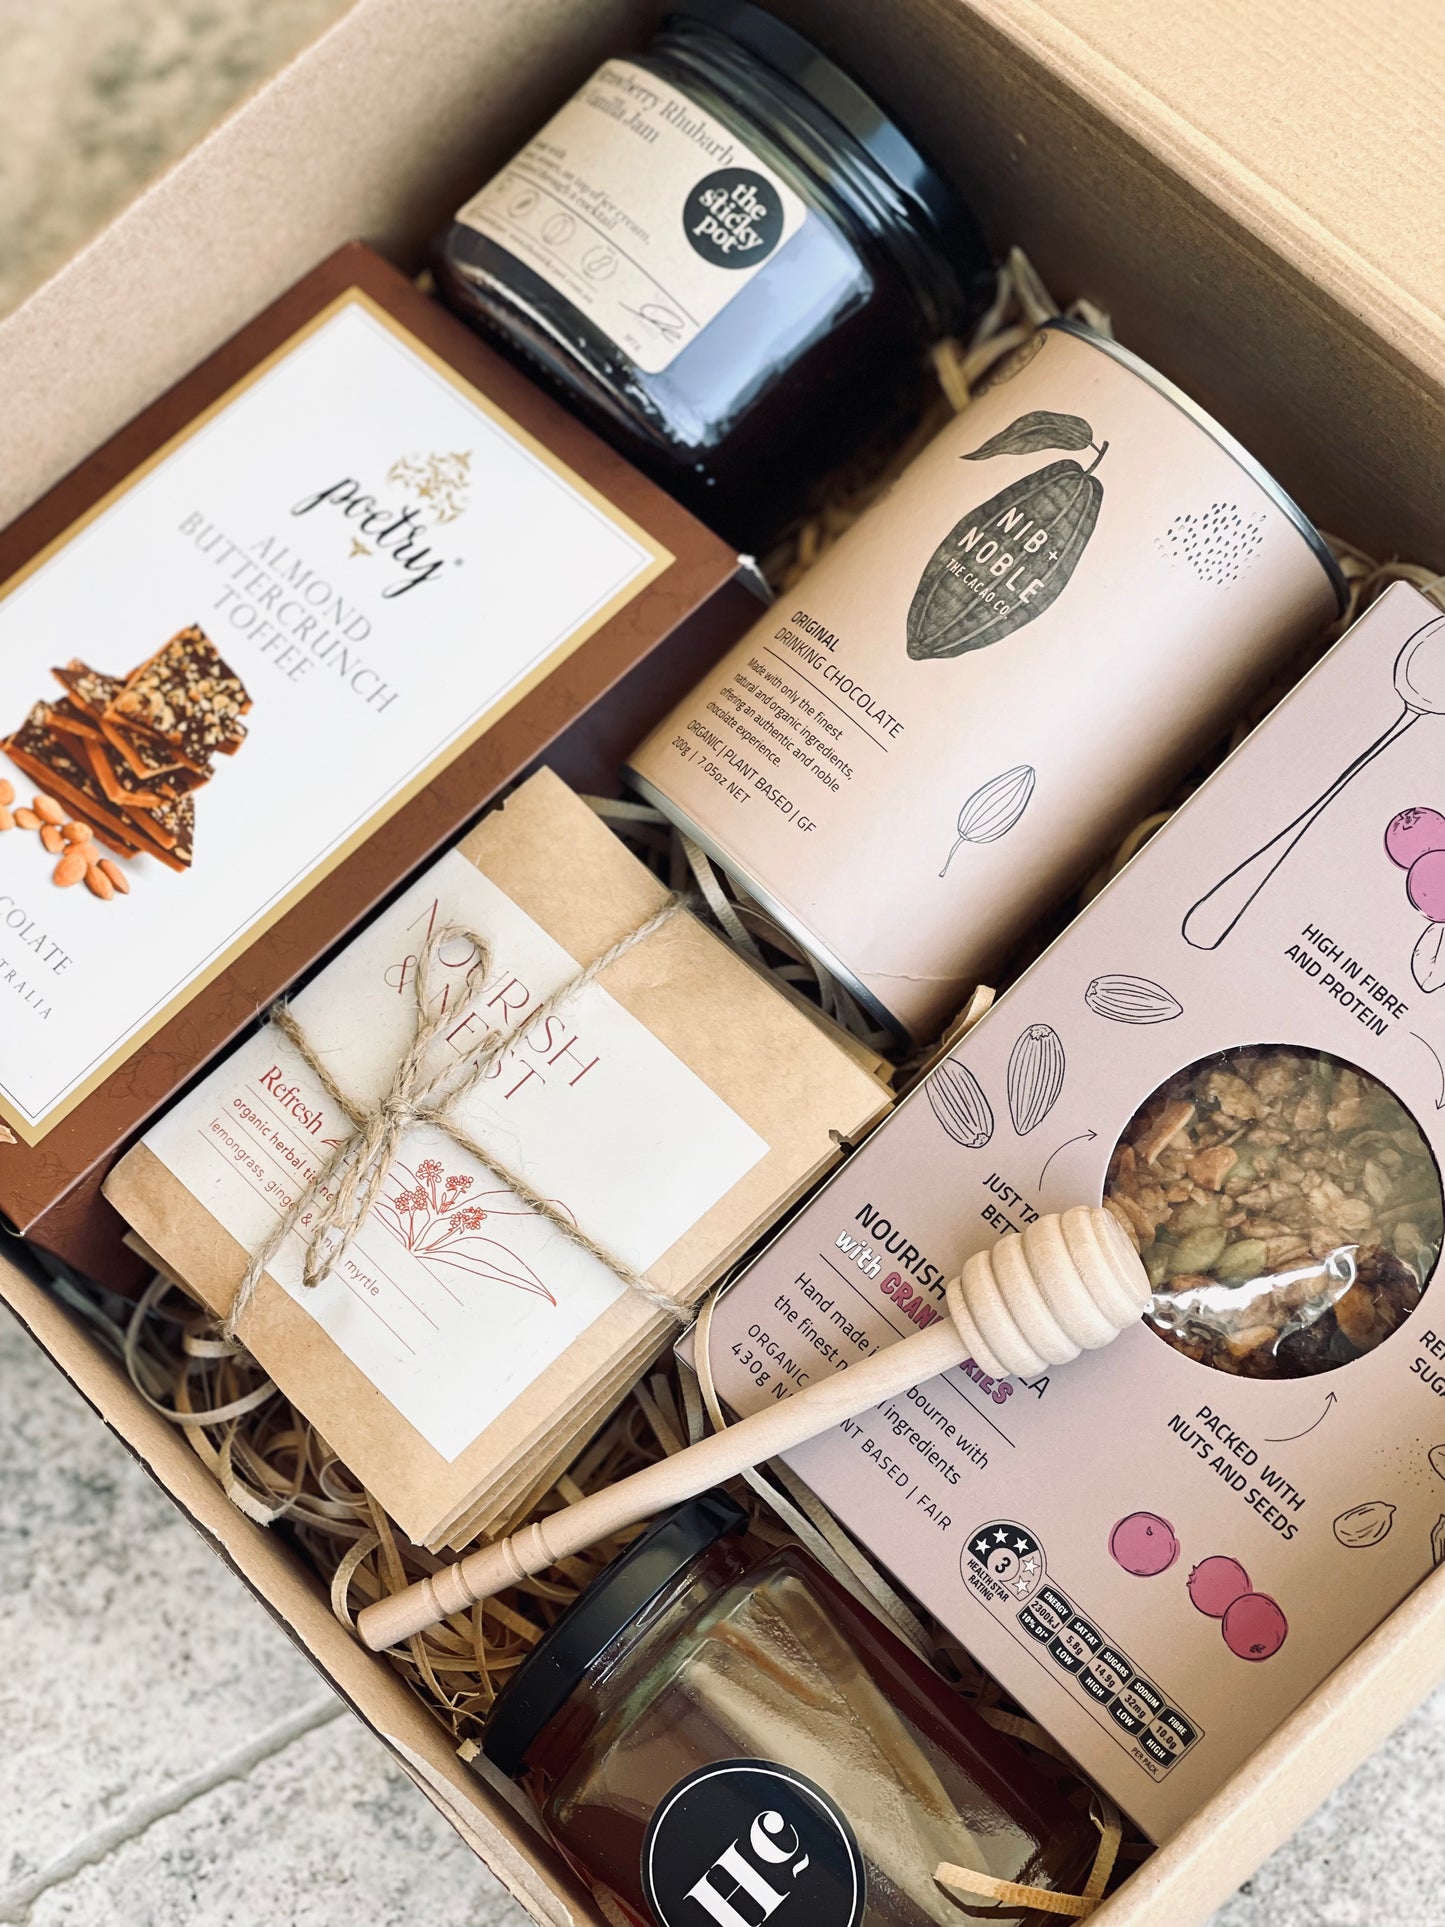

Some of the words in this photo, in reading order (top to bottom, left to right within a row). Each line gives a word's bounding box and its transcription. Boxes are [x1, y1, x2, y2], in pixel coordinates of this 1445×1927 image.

[623, 111, 661, 145] Jam
[660, 99, 735, 167] Rhubarb
[698, 187, 764, 251] sticky
[731, 183, 767, 221] the
[692, 214, 738, 254] pot
[290, 477, 445, 599] poetry
[996, 506, 1048, 553] NIB
[945, 558, 966, 577] THE
[963, 572, 996, 603] CACAO
[957, 526, 1045, 604] NOBLE
[178, 510, 400, 713] BUTTERCRUNCH
[249, 536, 372, 643] ALMOND
[212, 584, 315, 683] TOFFEE
[791, 610, 840, 652] ORIGINAL
[747, 657, 766, 676] Made
[764, 671, 782, 690] with
[781, 685, 800, 704] only
[798, 699, 815, 716] the
[813, 711, 844, 741] finest
[774, 627, 827, 670] DRINKING
[823, 664, 905, 739] CHOCOLATE
[706, 700, 738, 728] chocolate
[735, 723, 781, 768] experience.
[720, 686, 746, 712] offering
[743, 703, 755, 717] an
[754, 714, 795, 751] authentic
[792, 747, 815, 767] and
[811, 764, 840, 793] noble
[733, 672, 756, 693] natural
[754, 689, 773, 706] and
[769, 702, 802, 731] organic
[800, 725, 854, 780] ingredients,
[671, 735, 692, 757] 200g
[697, 755, 728, 786] 7.05oz
[726, 781, 751, 804] NET
[686, 719, 723, 751] ORGANIC
[723, 748, 759, 781] PLANT
[754, 776, 794, 814] BASED
[797, 815, 817, 835] GF
[1284, 944, 1322, 977] AND
[1318, 973, 1389, 1037] PROTEIN
[1301, 923, 1345, 963] HIGH
[1340, 957, 1363, 980] IN
[1358, 974, 1409, 1020] FIBRE
[258, 1064, 324, 1136] Refresh
[233, 1098, 271, 1137] organic
[269, 1131, 306, 1172] herbal
[302, 1164, 337, 1202] tisne
[208, 1117, 265, 1181] lemongrass,
[264, 1180, 298, 1212] ginge
[301, 1213, 313, 1226] &
[344, 1259, 380, 1297] myrtle
[982, 1172, 1023, 1208] JUST
[980, 1203, 1022, 1235] BETT
[835, 1229, 882, 1279] with
[855, 1203, 947, 1301] NOURISH
[731, 1342, 771, 1387] 430g
[794, 1272, 835, 1313] Hand
[830, 1310, 870, 1352] made
[904, 1384, 956, 1438] bourne
[956, 1434, 989, 1470] with
[774, 1294, 798, 1323] the
[797, 1317, 839, 1363] finest
[883, 1404, 961, 1485] ingredients
[748, 1324, 810, 1387] ORGANIC
[861, 1438, 909, 1487] BASED
[916, 1494, 952, 1531] FAIR
[1167, 1414, 1214, 1459] NUTS
[1208, 1455, 1248, 1492] AND
[1243, 1487, 1299, 1541] SEEDS
[1195, 1405, 1258, 1467] PACKED
[1259, 1465, 1306, 1512] WITH
[967, 1559, 993, 1586] HEALTH
[990, 1581, 1010, 1602] STAR
[968, 1574, 994, 1601] RATING
[994, 1556, 1012, 1574] 3
[1021, 1612, 1036, 1629] 10%
[1030, 1600, 1061, 1629] 2300kJ
[1043, 1591, 1069, 1616] ENERGY
[1055, 1647, 1075, 1666] LOW
[1066, 1635, 1084, 1656] 5.8g
[1074, 1621, 1089, 1636] SAT
[1084, 1632, 1099, 1647] FAT
[1085, 1676, 1105, 1697] HIGH
[1094, 1664, 1116, 1689] 14.9g
[1103, 1651, 1129, 1678] SUGARS
[1116, 1708, 1135, 1727] LOW
[1124, 1694, 1147, 1719] 32mg
[1134, 1682, 1160, 1709] SODIUM
[1146, 1738, 1167, 1759] HIGH
[1155, 1725, 1178, 1750] 10.0g
[1167, 1716, 1188, 1736] FIBRE
[1131, 1746, 1145, 1761] PER
[1142, 1758, 1160, 1775] PACK
